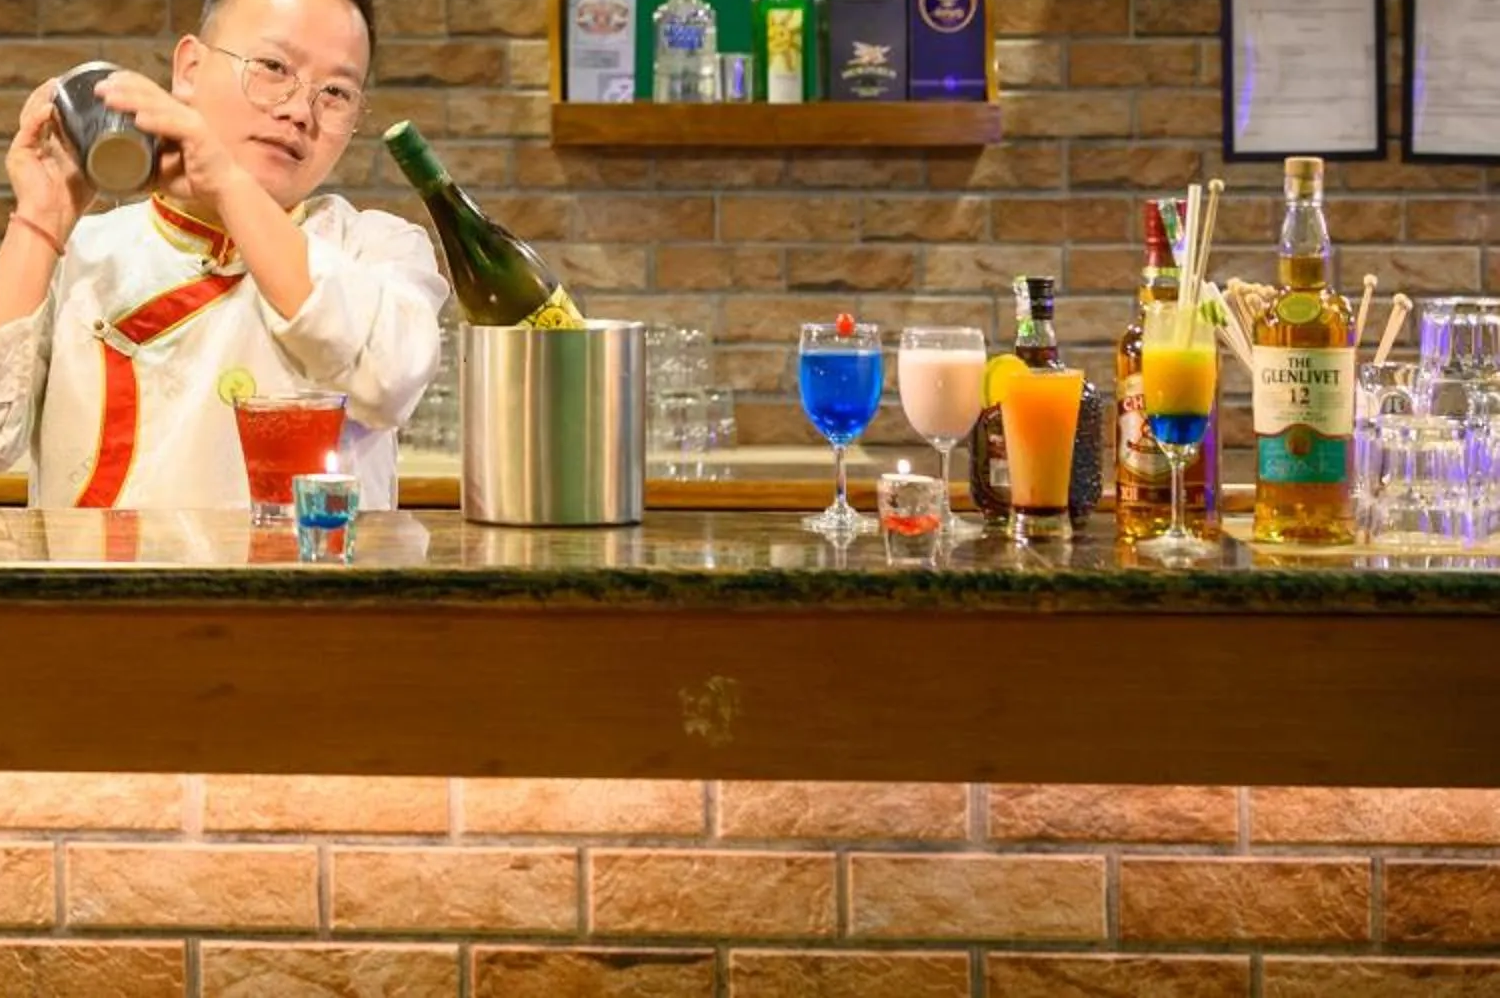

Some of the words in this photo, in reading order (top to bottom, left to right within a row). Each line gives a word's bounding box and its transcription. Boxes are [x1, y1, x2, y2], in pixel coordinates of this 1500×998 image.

[1288, 356, 1312, 369] THE
[1261, 368, 1340, 385] GLENLIVET
[1290, 386, 1310, 404] 12
